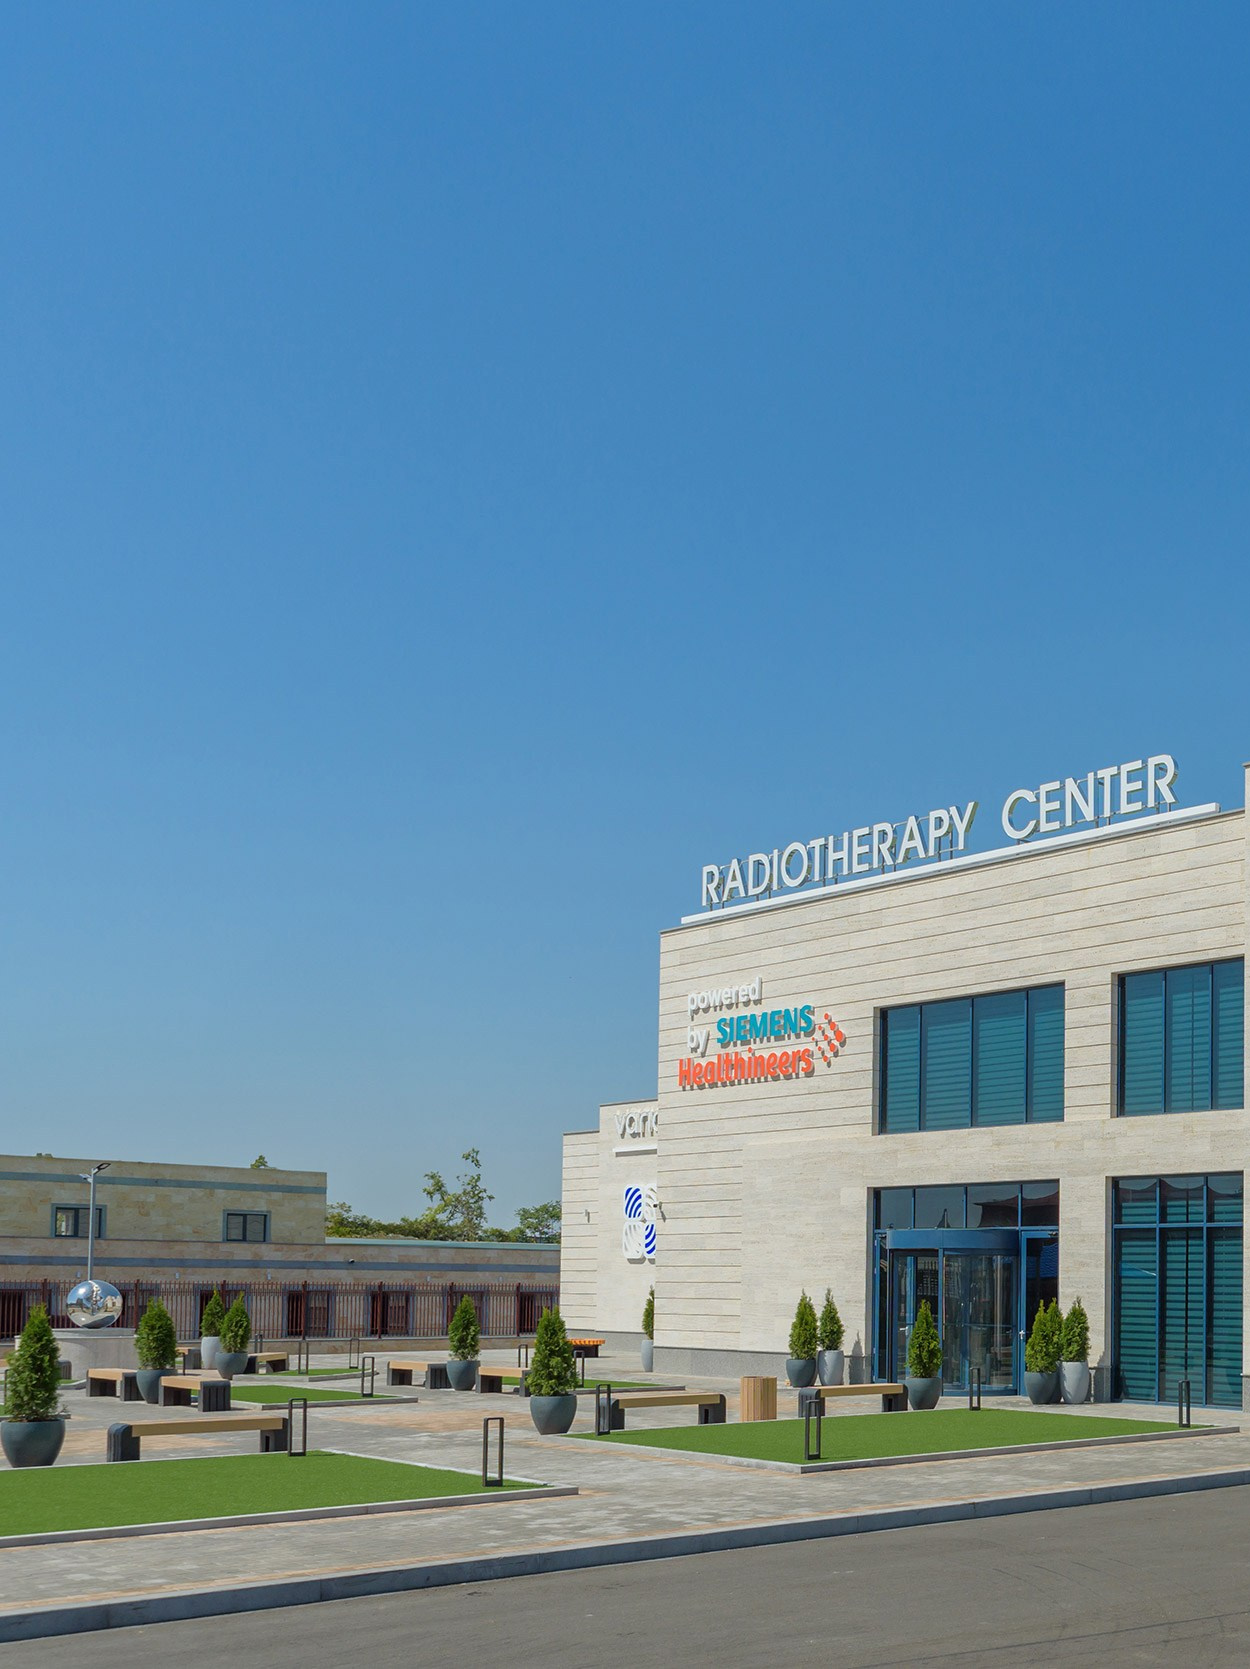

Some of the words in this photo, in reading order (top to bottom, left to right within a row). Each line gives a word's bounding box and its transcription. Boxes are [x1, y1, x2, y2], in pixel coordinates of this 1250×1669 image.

[702, 801, 979, 906] RADIOTHERAPY
[1001, 754, 1179, 840] CENTER
[688, 976, 763, 1017] powered
[687, 1026, 710, 1055] by
[716, 1004, 815, 1045] SIEMENS
[678, 1046, 813, 1087] Healthineers
